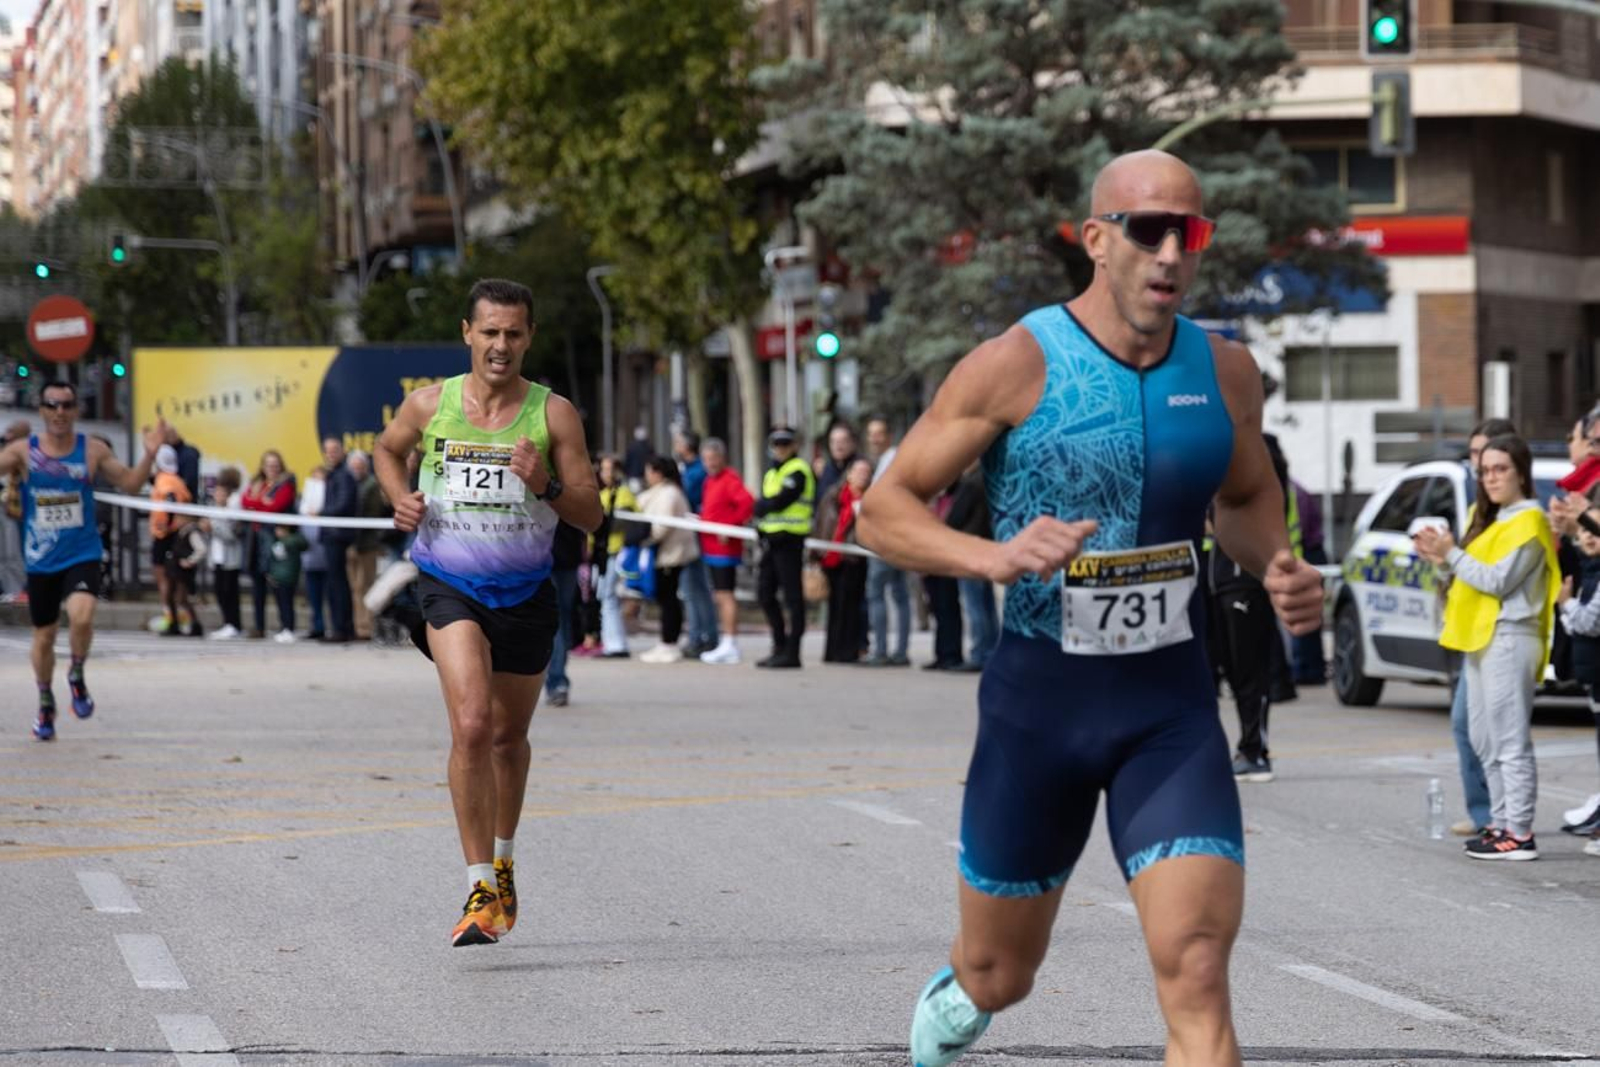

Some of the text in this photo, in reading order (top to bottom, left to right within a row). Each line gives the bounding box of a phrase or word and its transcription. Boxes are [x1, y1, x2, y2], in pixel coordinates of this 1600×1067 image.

[461, 467, 504, 489] 121
[1068, 557, 1100, 577] XXV
[1092, 588, 1166, 630] 731
